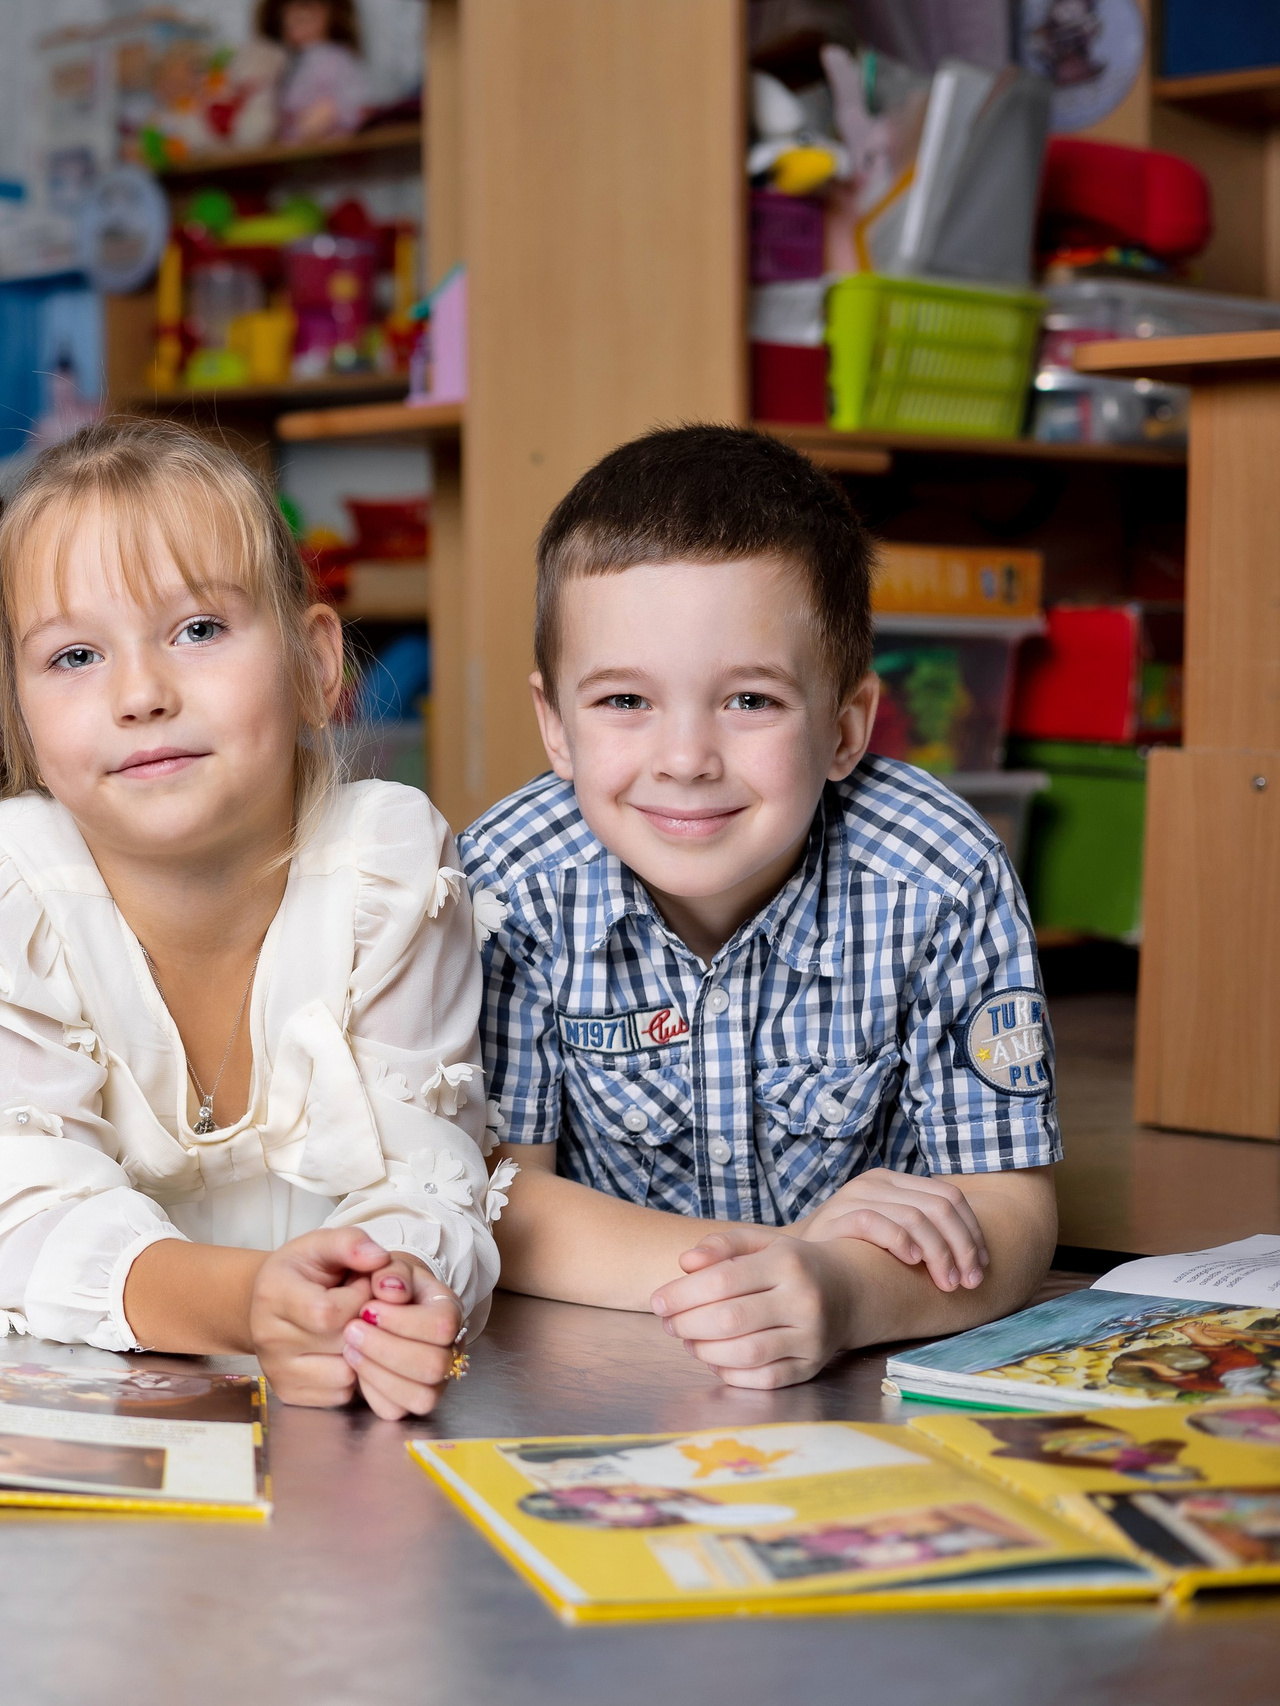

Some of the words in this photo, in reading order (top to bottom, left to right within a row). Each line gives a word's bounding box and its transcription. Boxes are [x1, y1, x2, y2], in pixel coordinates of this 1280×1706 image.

[564, 1019, 627, 1049] N1971
[987, 997, 1041, 1036] TURN
[993, 1029, 1044, 1064] AND
